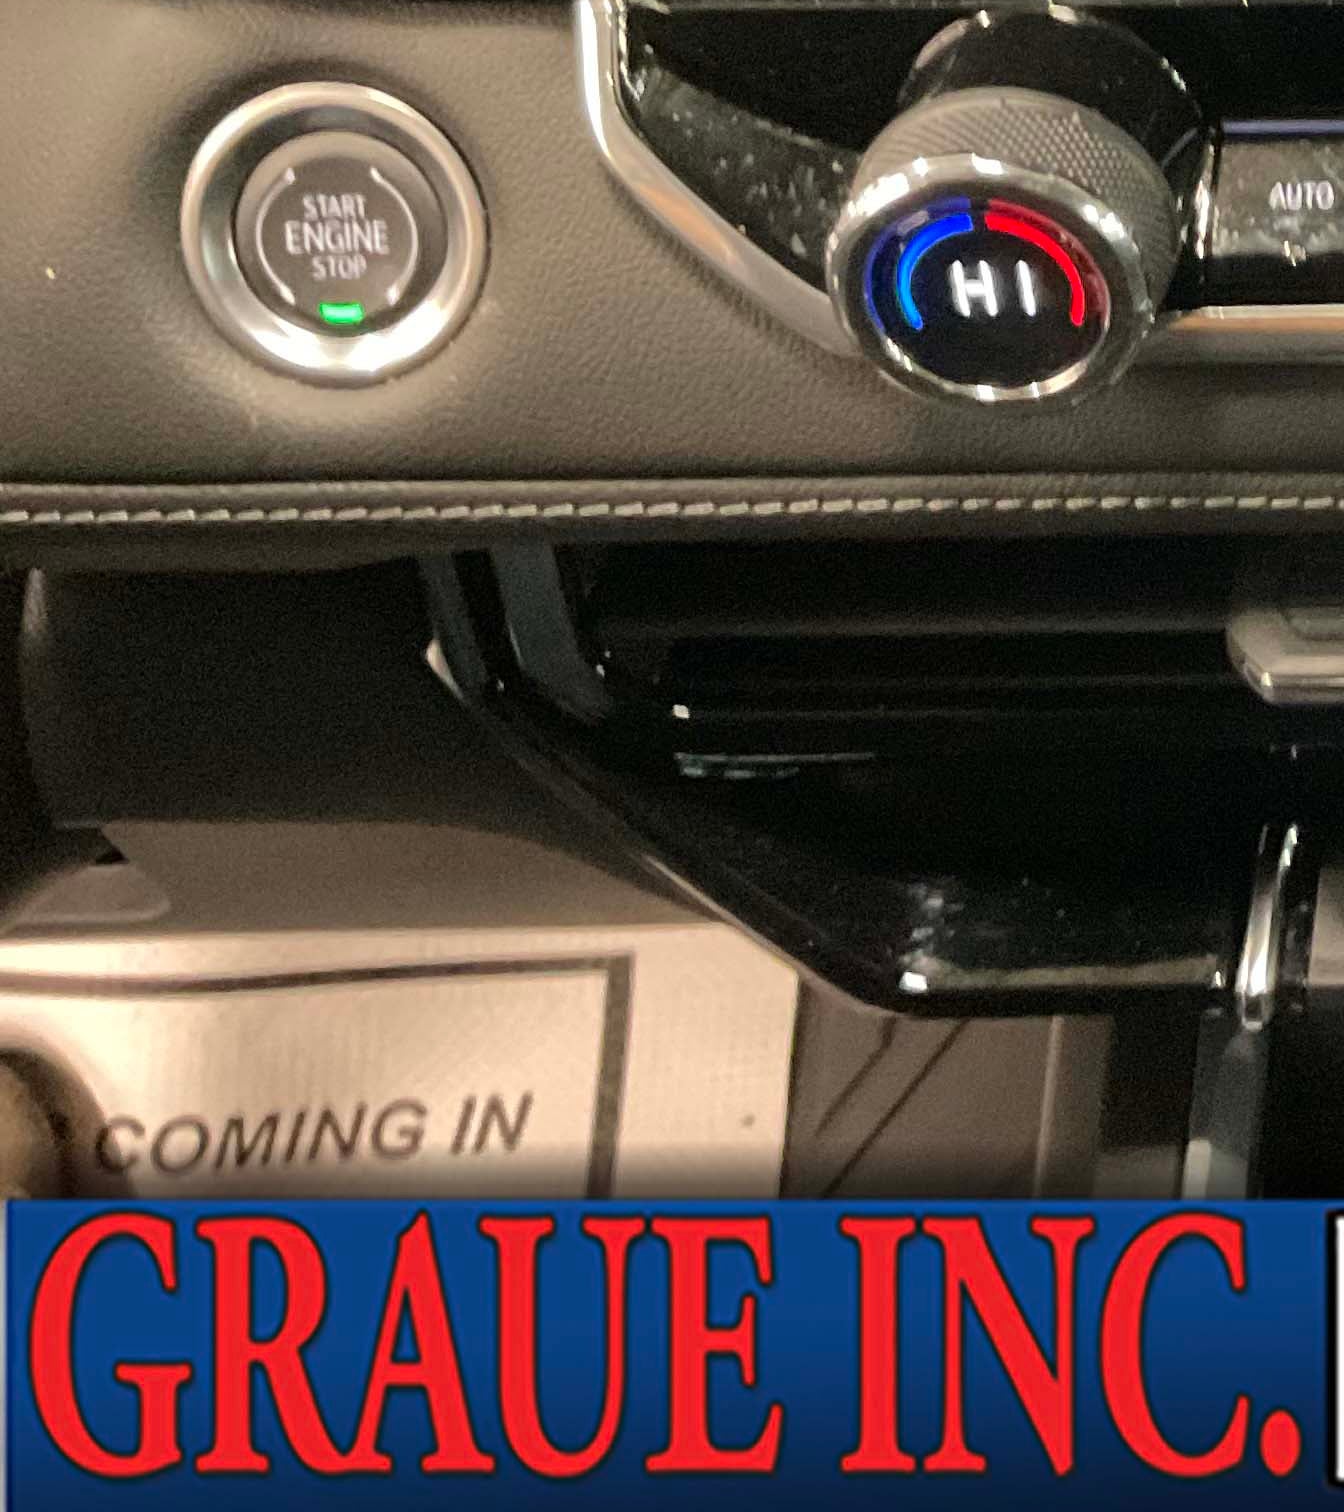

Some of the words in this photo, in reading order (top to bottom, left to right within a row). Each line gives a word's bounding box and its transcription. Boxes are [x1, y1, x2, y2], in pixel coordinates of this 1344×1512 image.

[302, 194, 367, 221] START
[1268, 180, 1336, 212] AUTO
[284, 219, 390, 255] ENGINE
[311, 254, 368, 281] STOP
[949, 259, 1038, 318] HI
[94, 1097, 429, 1176] COMING
[449, 1091, 536, 1157] IN
